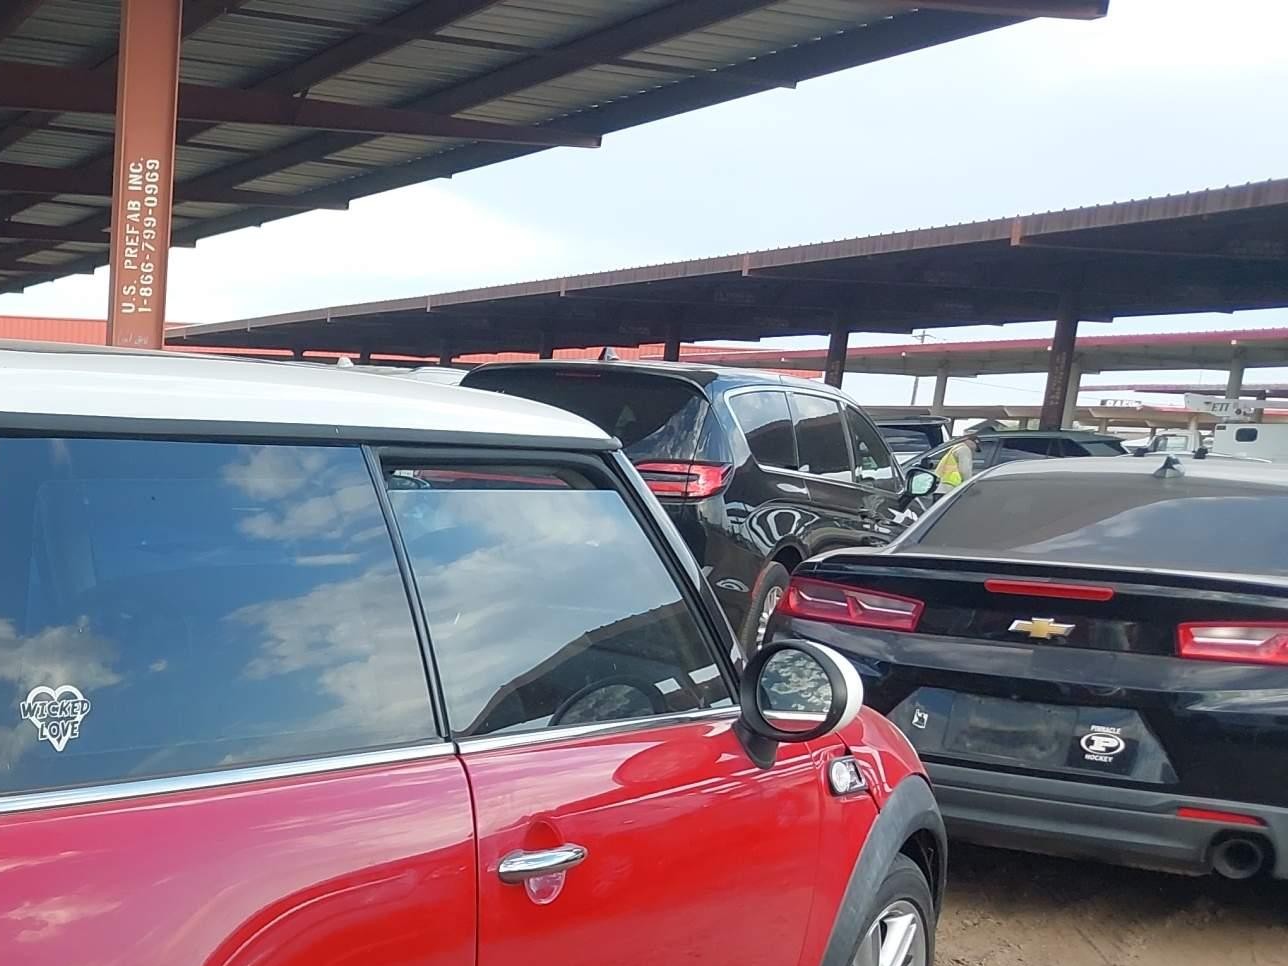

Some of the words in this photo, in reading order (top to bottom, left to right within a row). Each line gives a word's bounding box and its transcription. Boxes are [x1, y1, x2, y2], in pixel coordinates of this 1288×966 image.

[128, 157, 144, 191] INC.
[124, 200, 141, 270] PREFAB
[138, 159, 160, 312] 1-866-799-0969
[122, 280, 137, 313] U.S.
[20, 699, 91, 719] WICKED
[38, 721, 80, 741] LOVE
[1085, 753, 1114, 763] HOCKEY
